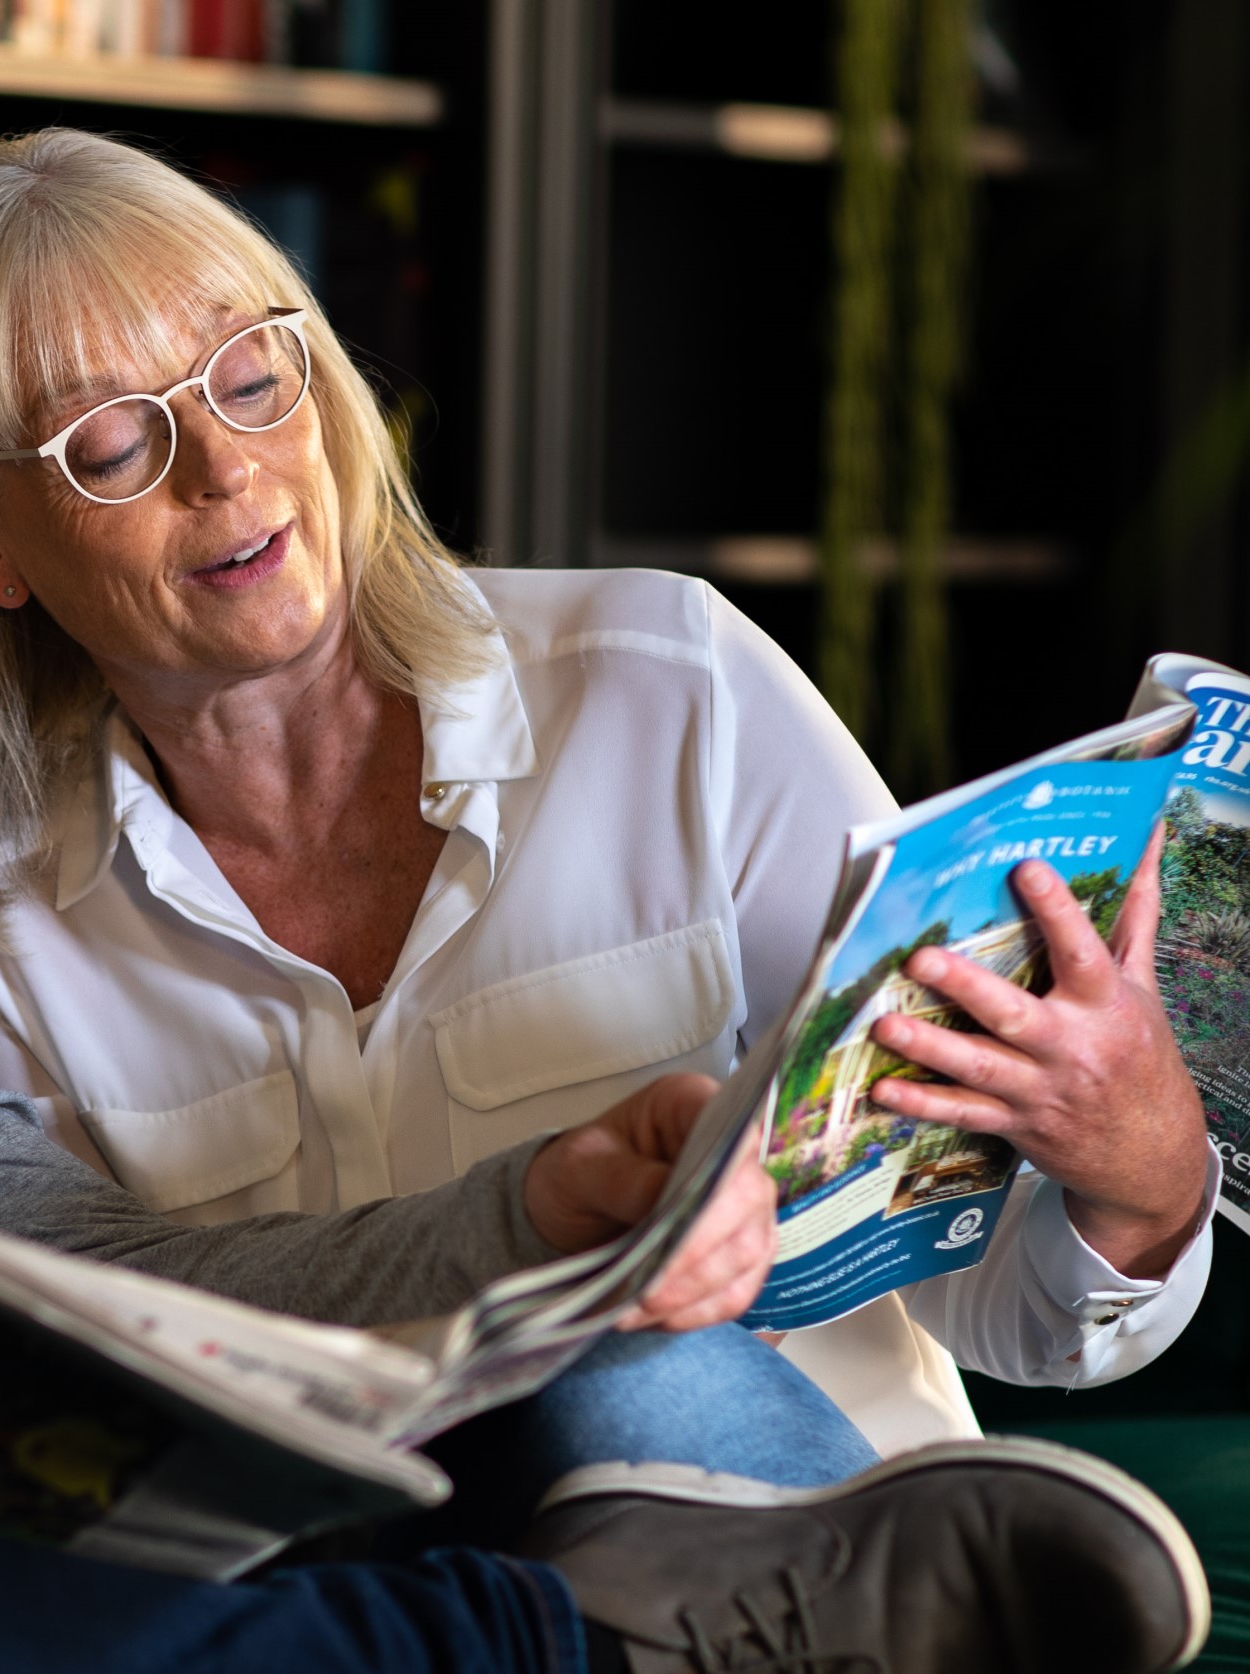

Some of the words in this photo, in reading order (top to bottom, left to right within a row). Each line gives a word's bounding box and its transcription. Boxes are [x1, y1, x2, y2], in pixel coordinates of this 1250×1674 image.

[987, 835, 1118, 867] HARTLEY
[1211, 1079, 1236, 1097] ideas
[1237, 1094, 1248, 1103] to
[1223, 1096, 1243, 1110] and
